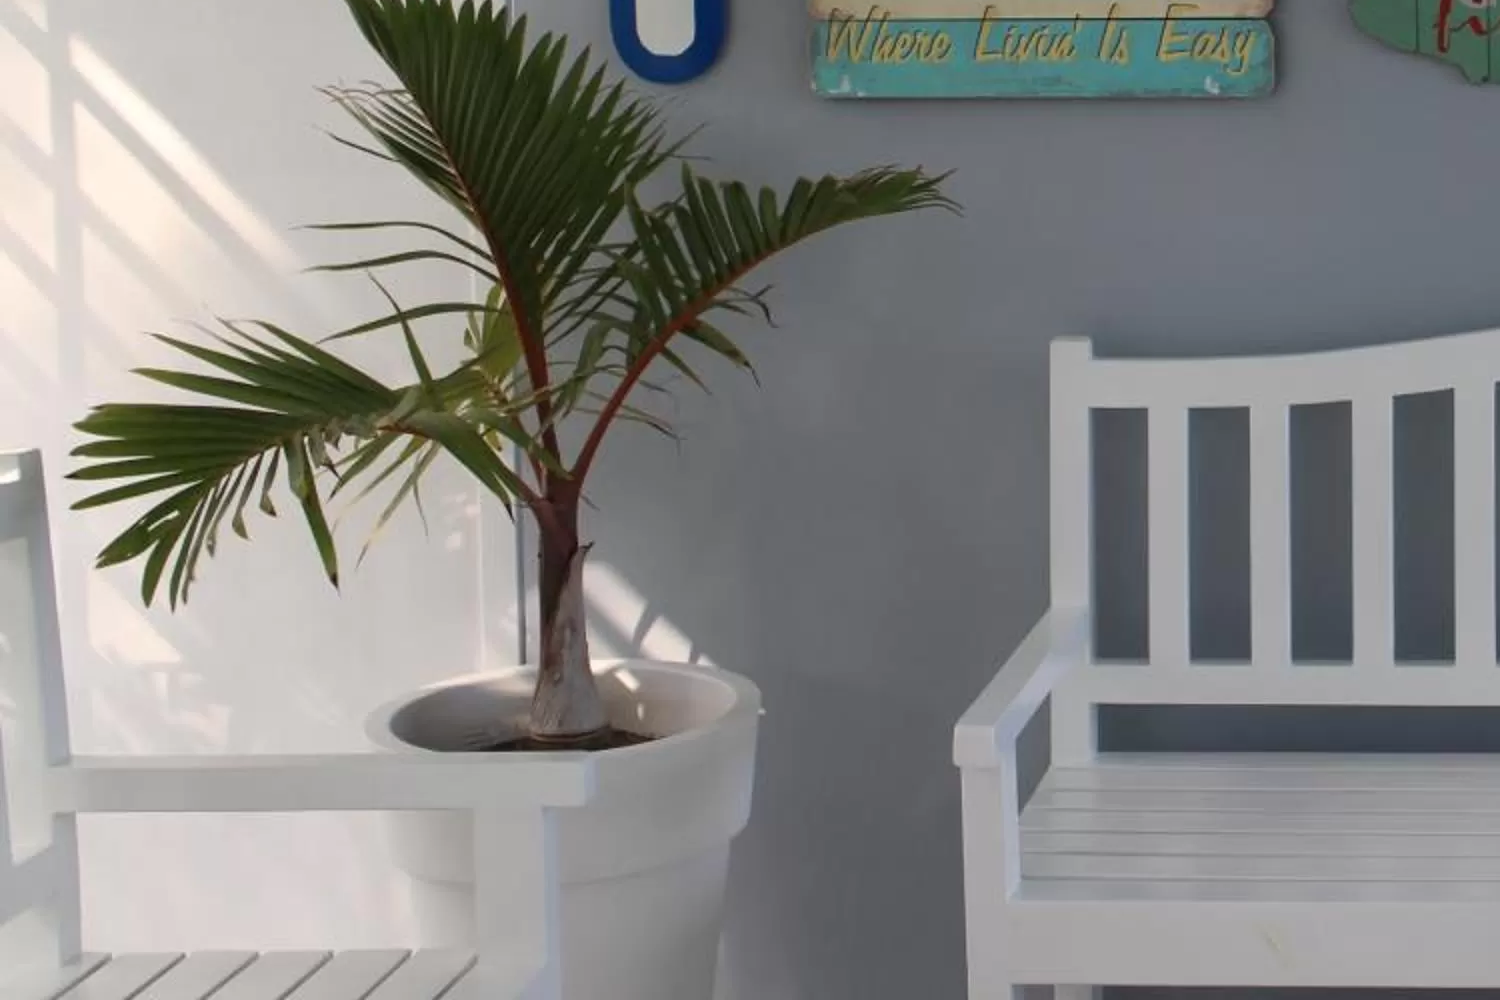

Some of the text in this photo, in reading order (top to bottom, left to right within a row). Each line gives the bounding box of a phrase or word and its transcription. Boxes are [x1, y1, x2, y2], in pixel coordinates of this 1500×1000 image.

[825, 2, 1257, 76] Where Livin' Is Easy
